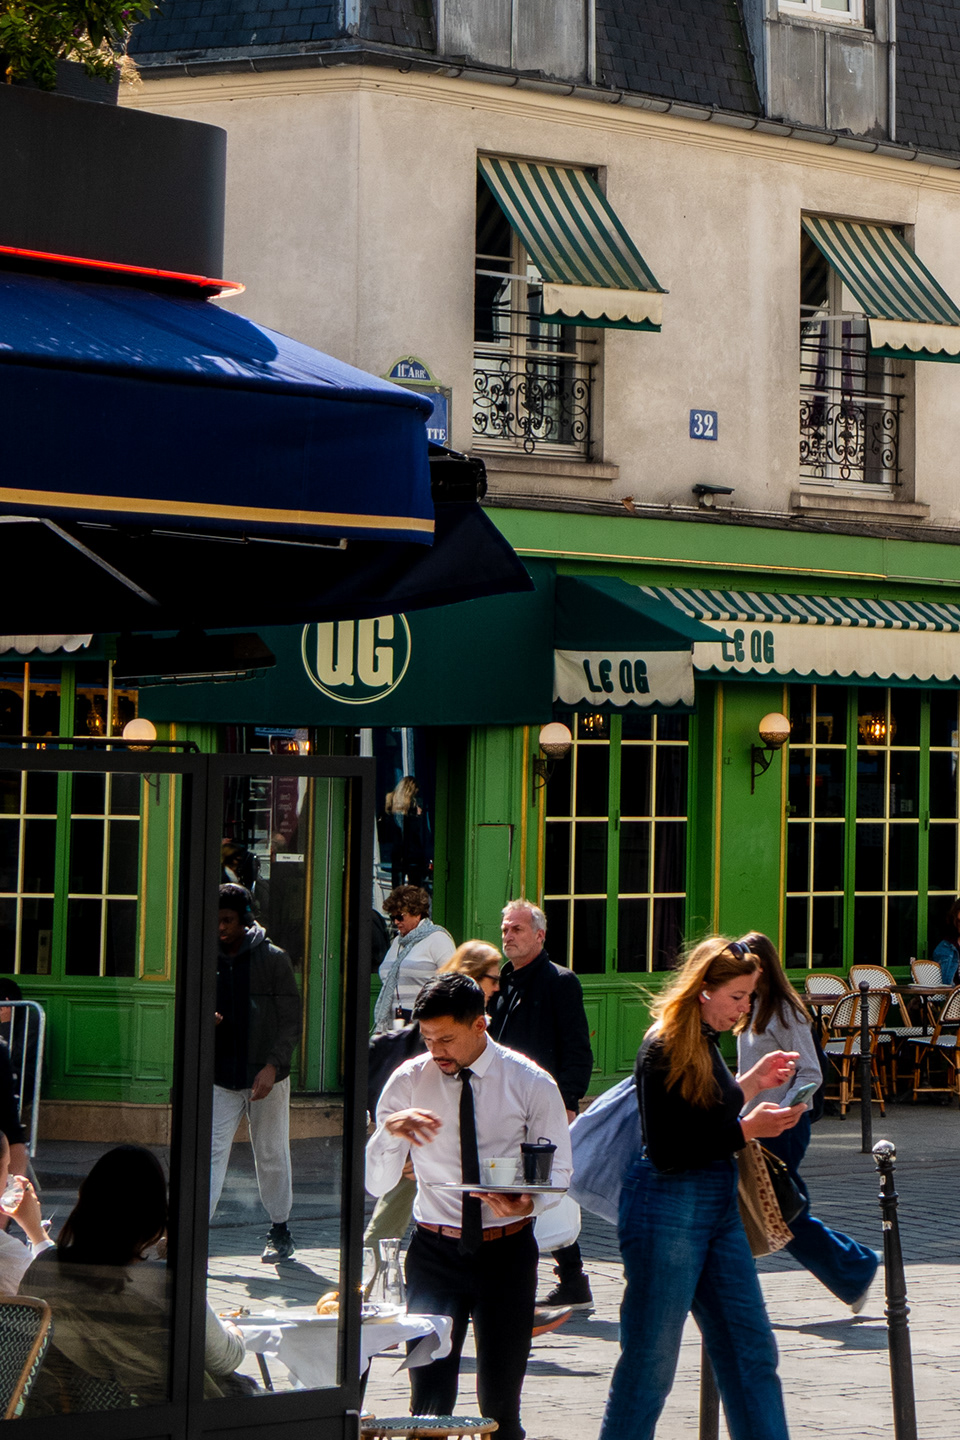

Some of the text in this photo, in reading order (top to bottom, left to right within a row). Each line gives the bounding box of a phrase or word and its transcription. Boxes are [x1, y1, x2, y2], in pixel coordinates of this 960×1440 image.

[694, 413, 714, 436] 32
[316, 615, 395, 687] QG
[721, 627, 775, 664] LE QG
[583, 658, 650, 694] LE QG
